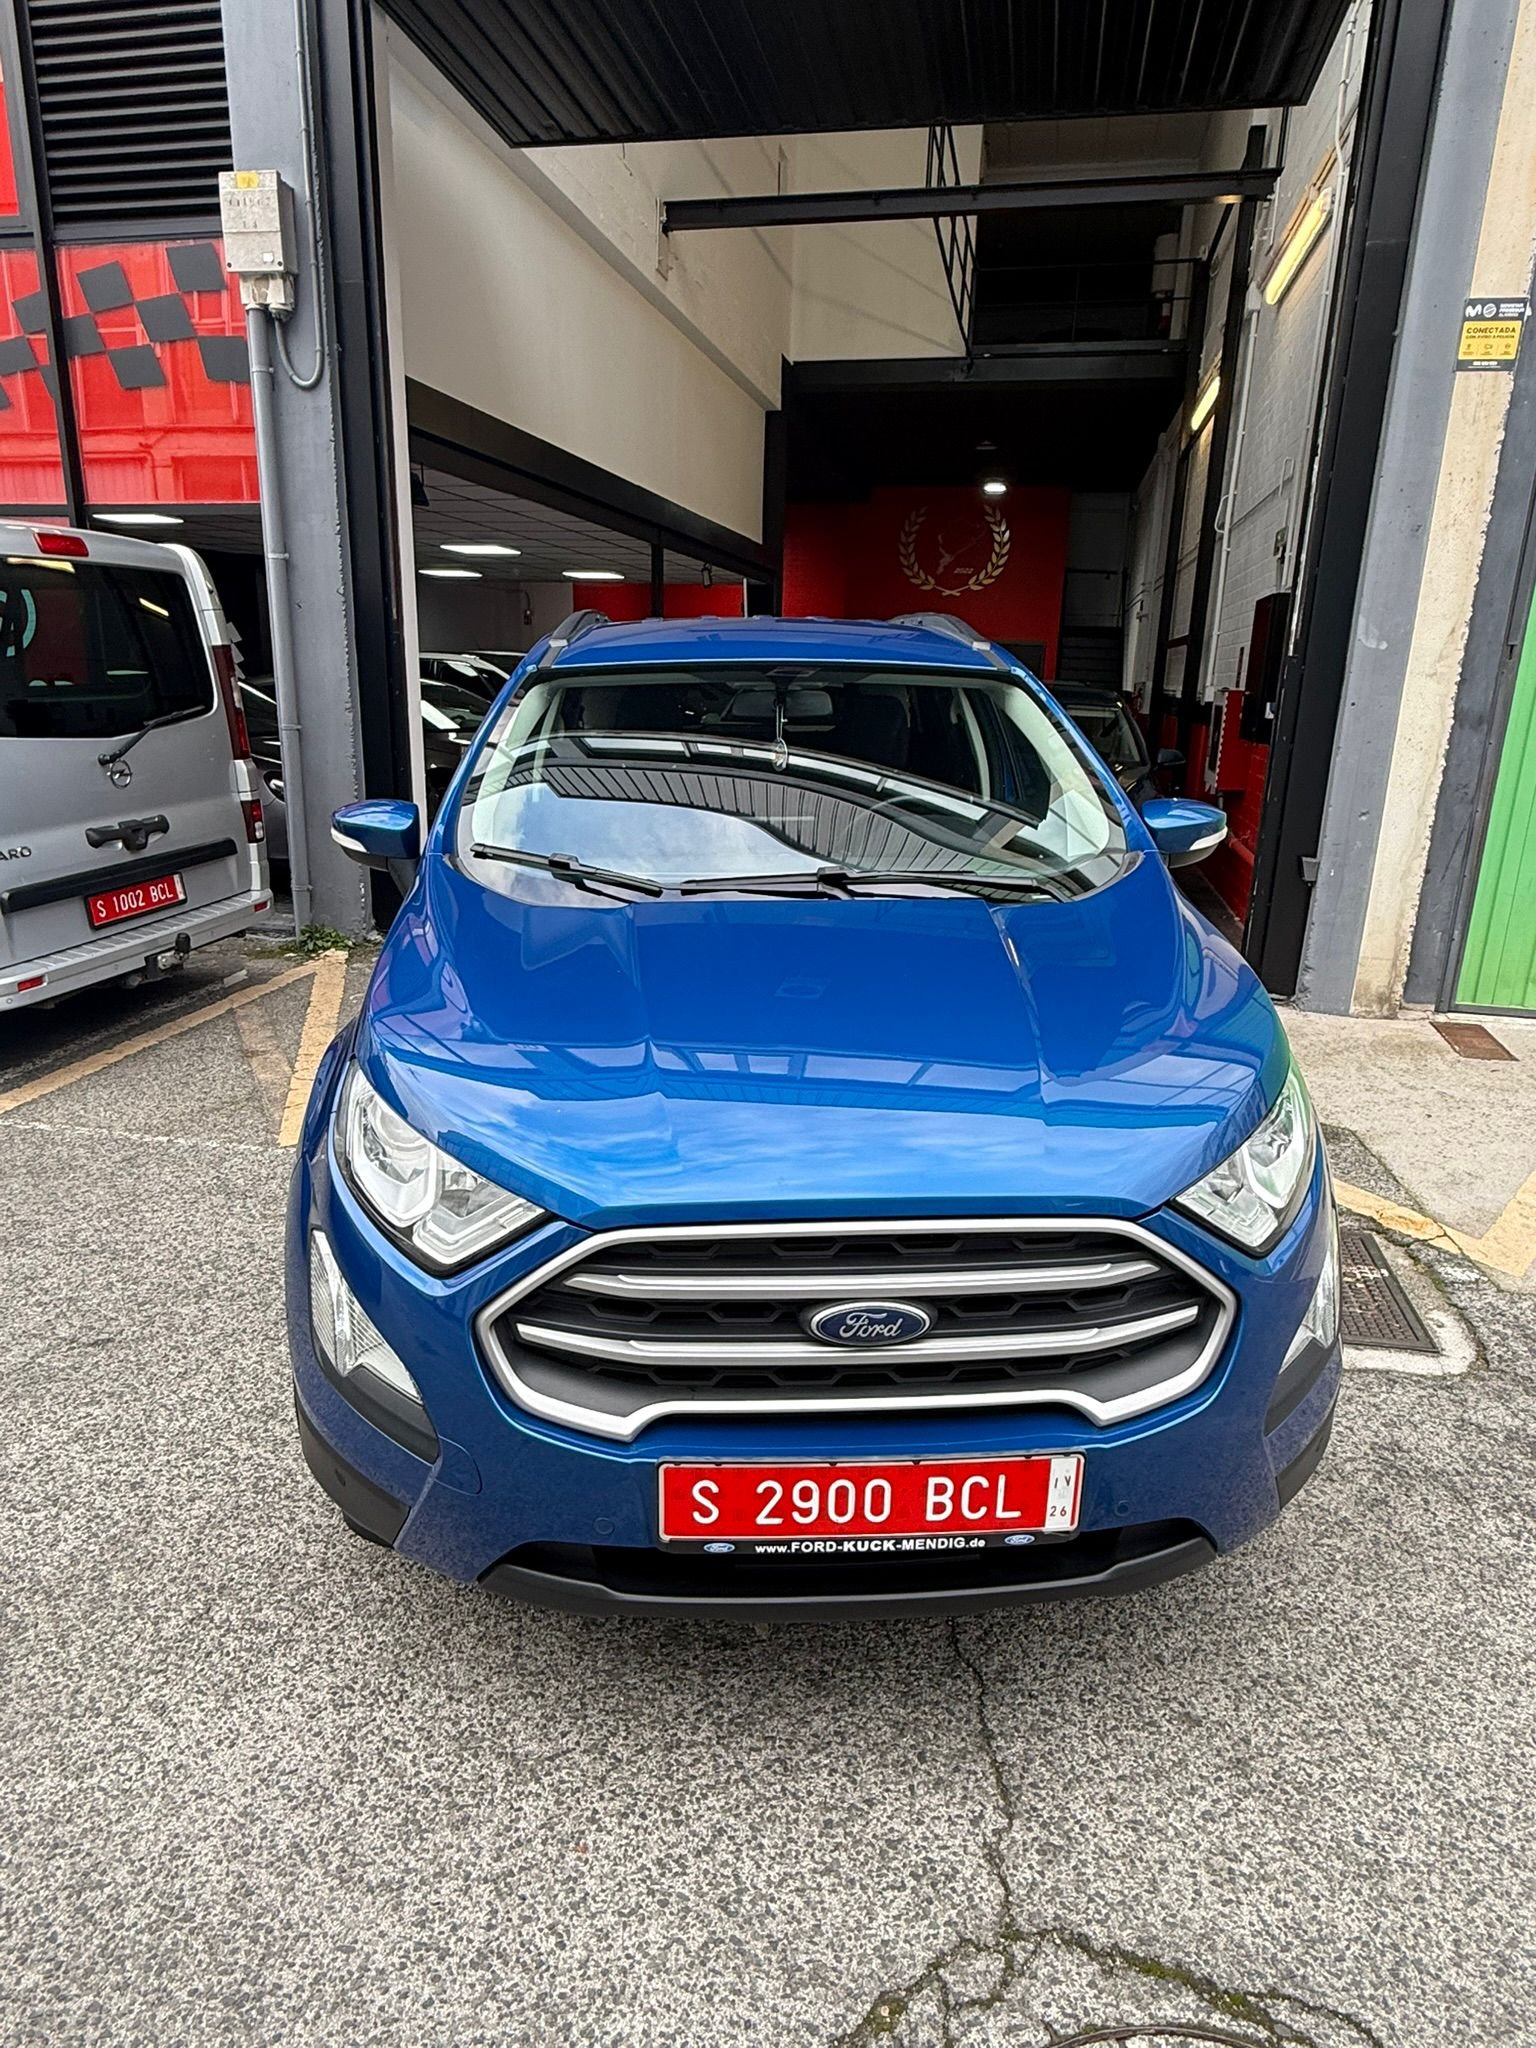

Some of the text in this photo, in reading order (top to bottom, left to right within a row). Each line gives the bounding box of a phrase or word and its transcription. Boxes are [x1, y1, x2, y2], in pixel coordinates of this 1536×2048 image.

[96, 900, 107, 918] S
[113, 890, 146, 913] 1002
[150, 882, 174, 903] BCL
[840, 1312, 903, 1338] Ford
[691, 1474, 1022, 1525] S 2900 BCL
[1050, 1505, 1067, 1517] 26
[755, 1537, 986, 1554] www.FORD-KUCK-MENDIG.de
